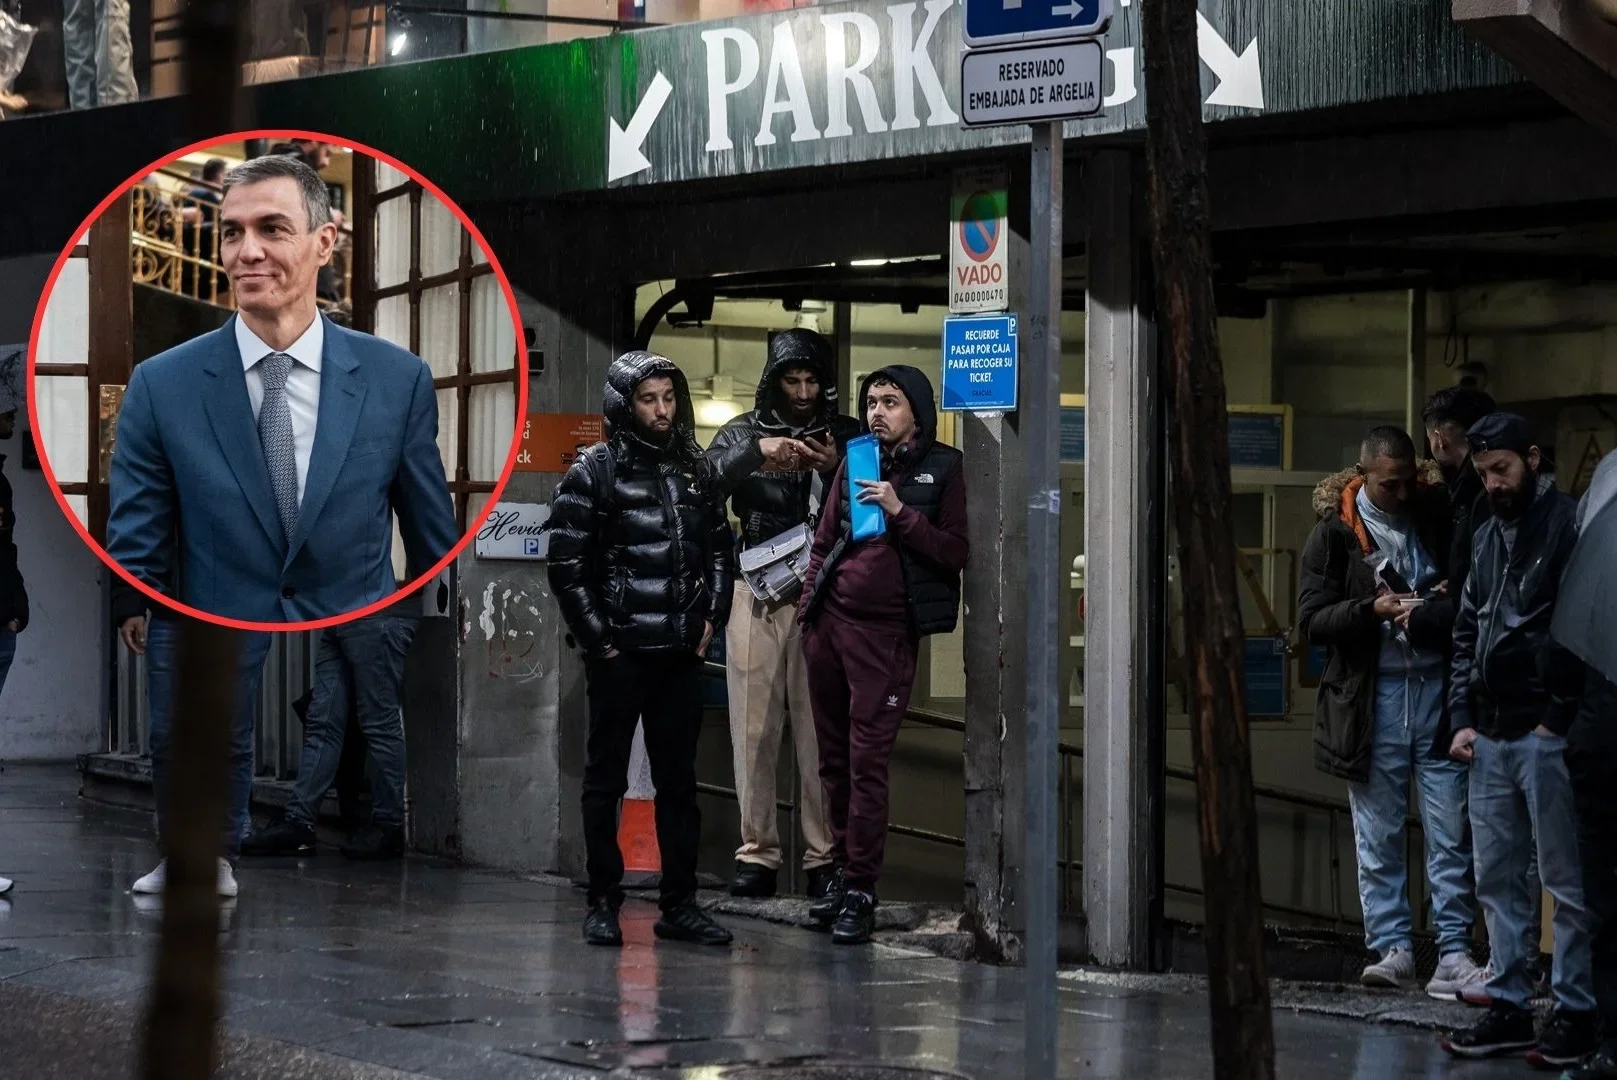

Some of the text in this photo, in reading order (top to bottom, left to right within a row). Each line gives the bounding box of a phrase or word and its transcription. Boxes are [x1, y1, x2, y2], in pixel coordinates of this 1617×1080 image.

[701, 0, 1137, 151] PARK
[999, 58, 1065, 81] RESERVADO
[969, 81, 1095, 110] EMBAJADA DE ARGELIA
[957, 263, 1002, 286] VADO
[954, 288, 1003, 303] 0400000470
[965, 329, 1000, 341] RECUERDE
[951, 343, 1011, 355] PASAR POR CAJA
[948, 357, 1013, 369] PARA RECOGER SU
[969, 372, 994, 383] TICKET.
[477, 510, 544, 541] Hevia
